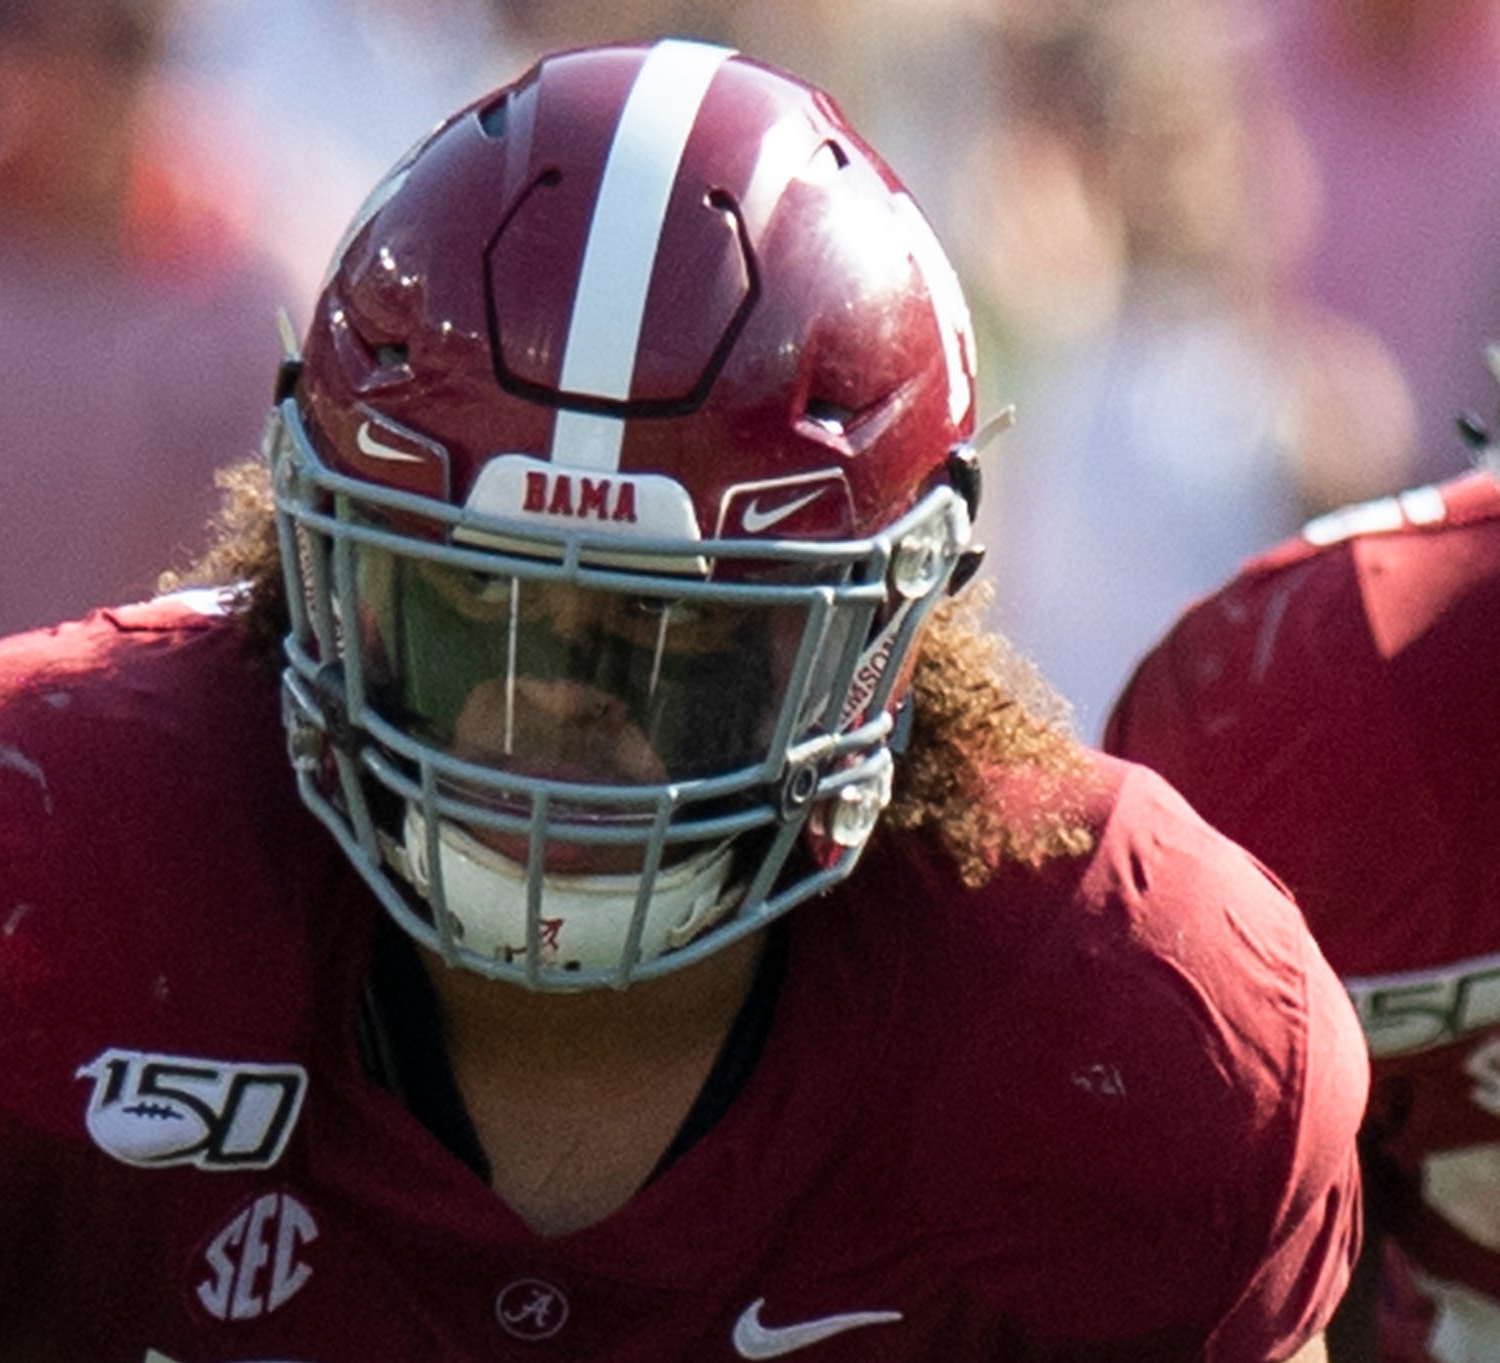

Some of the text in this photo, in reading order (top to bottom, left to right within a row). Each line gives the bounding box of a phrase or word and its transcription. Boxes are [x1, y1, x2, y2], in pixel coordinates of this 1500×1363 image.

[522, 470, 638, 524] BAMA
[98, 1055, 302, 1166] 150
[196, 1192, 319, 1321] SEC
